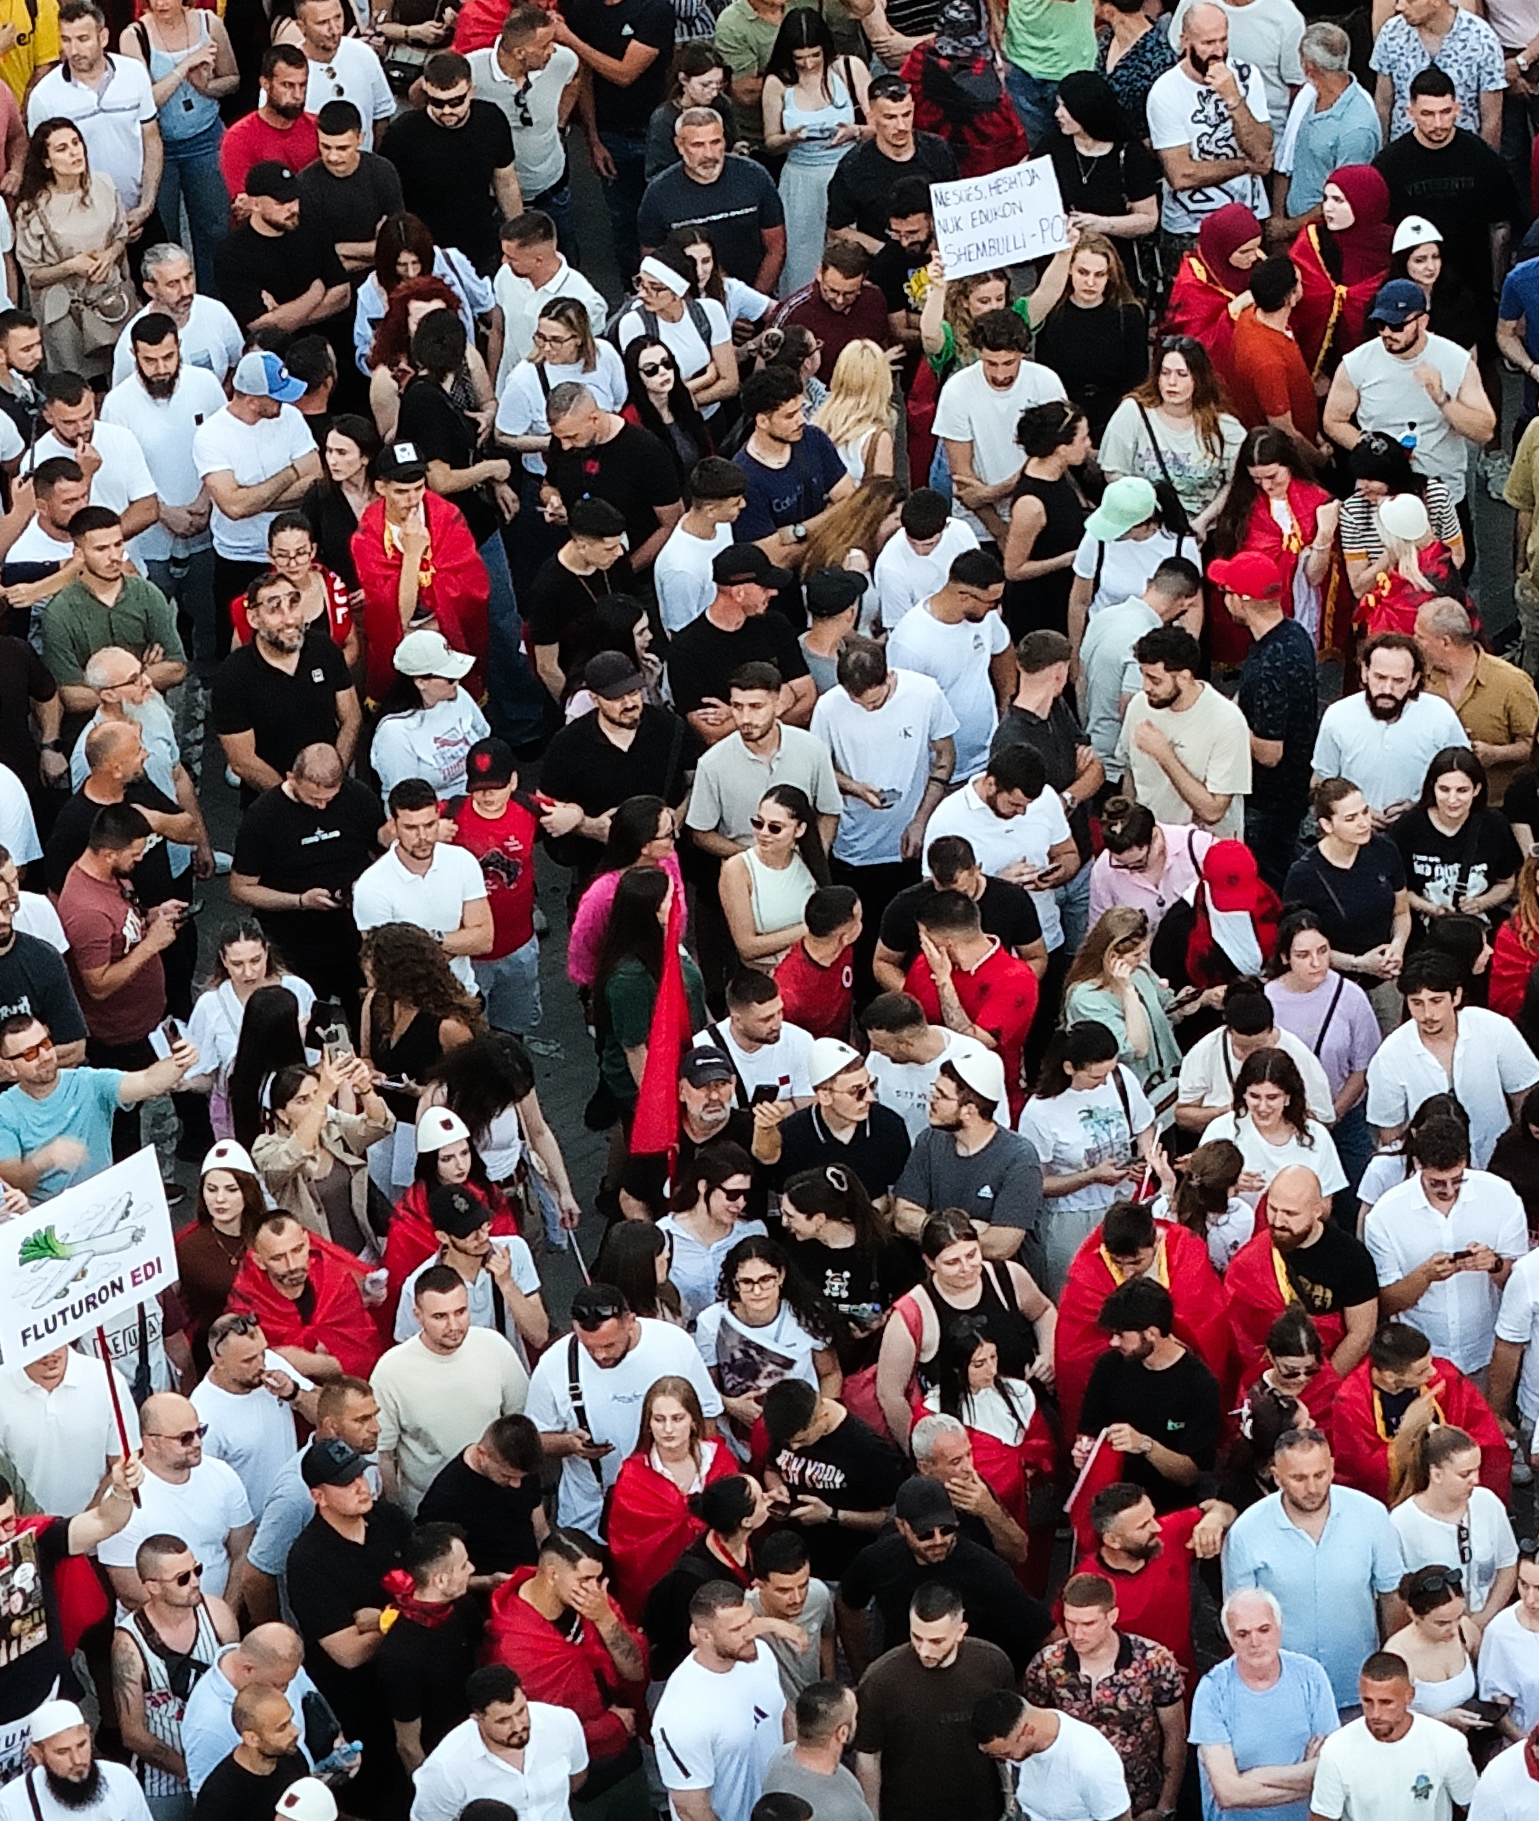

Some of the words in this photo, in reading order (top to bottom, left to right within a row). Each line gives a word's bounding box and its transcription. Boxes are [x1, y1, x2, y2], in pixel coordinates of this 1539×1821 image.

[937, 216, 963, 235] NUK
[971, 200, 1024, 227] EDUKON
[19, 1277, 126, 1348] FLUTURON
[128, 1256, 165, 1290] EDI
